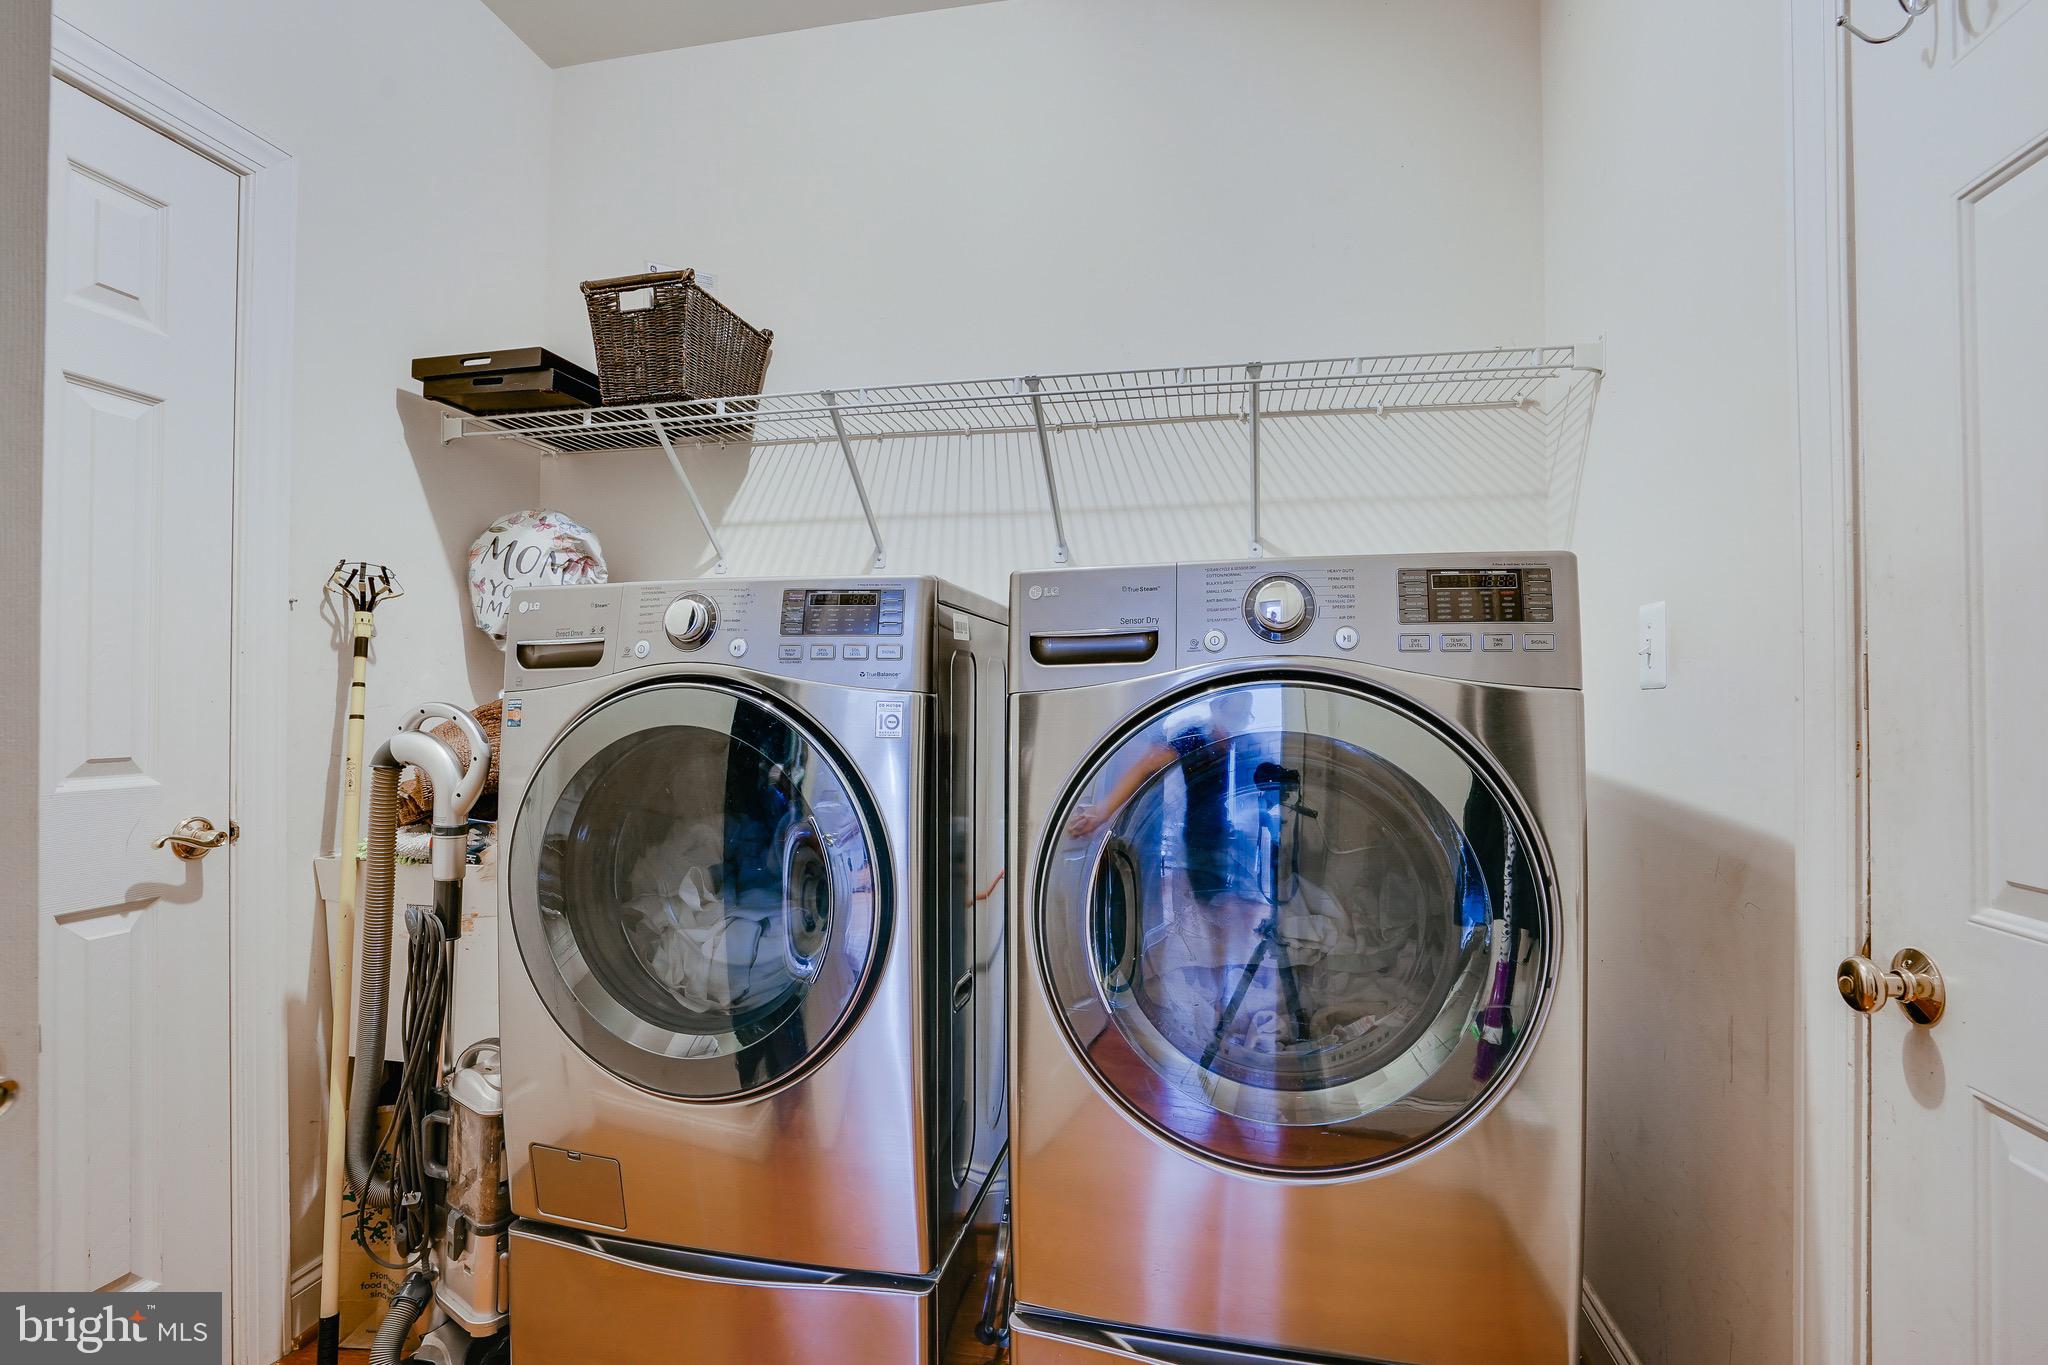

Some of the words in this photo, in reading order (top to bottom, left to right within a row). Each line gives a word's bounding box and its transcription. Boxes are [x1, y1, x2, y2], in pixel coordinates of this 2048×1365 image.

[481, 536, 573, 585] MOM
[1120, 617, 1144, 625] Sensor
[1146, 616, 1160, 625] Dry
[360, 1281, 382, 1290] food
